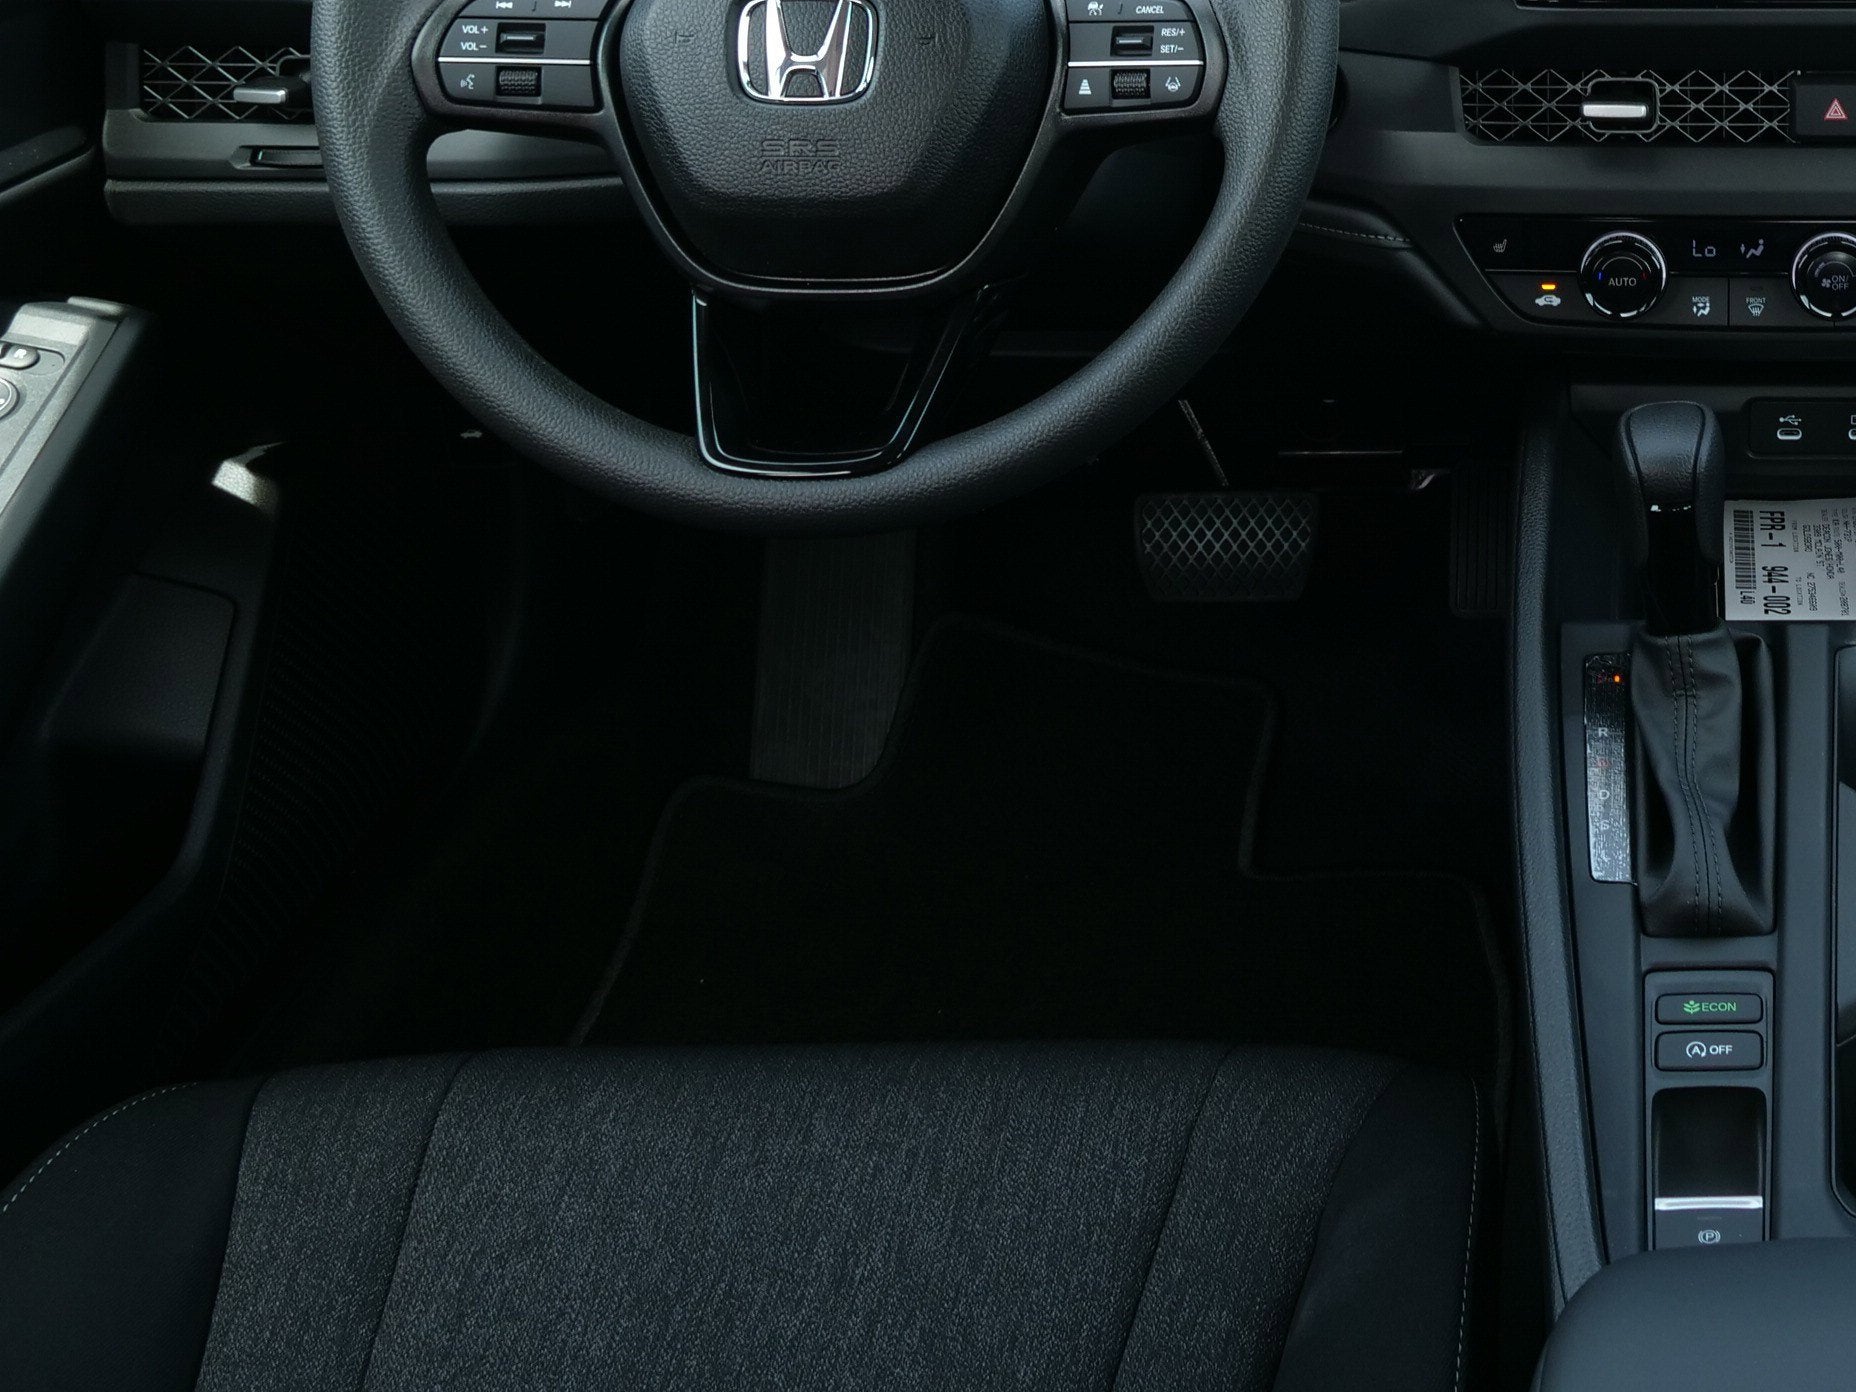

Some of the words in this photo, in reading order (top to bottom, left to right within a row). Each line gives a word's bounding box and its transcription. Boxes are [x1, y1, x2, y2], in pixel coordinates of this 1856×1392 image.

[1135, 5, 1164, 14] CANCEL
[1161, 27, 1186, 37] RES/+
[759, 140, 840, 155] SRS
[760, 160, 841, 174] AIRBAG
[1608, 277, 1637, 287] AUTO
[1831, 282, 1850, 290] OFF
[1759, 510, 1786, 548] FPR-1
[1762, 565, 1791, 615] 944-002
[1740, 591, 1755, 604] L40
[1598, 728, 1608, 737] R
[1600, 790, 1610, 800] D
[1701, 1001, 1737, 1012] ECON
[1709, 1044, 1733, 1056] OFF
